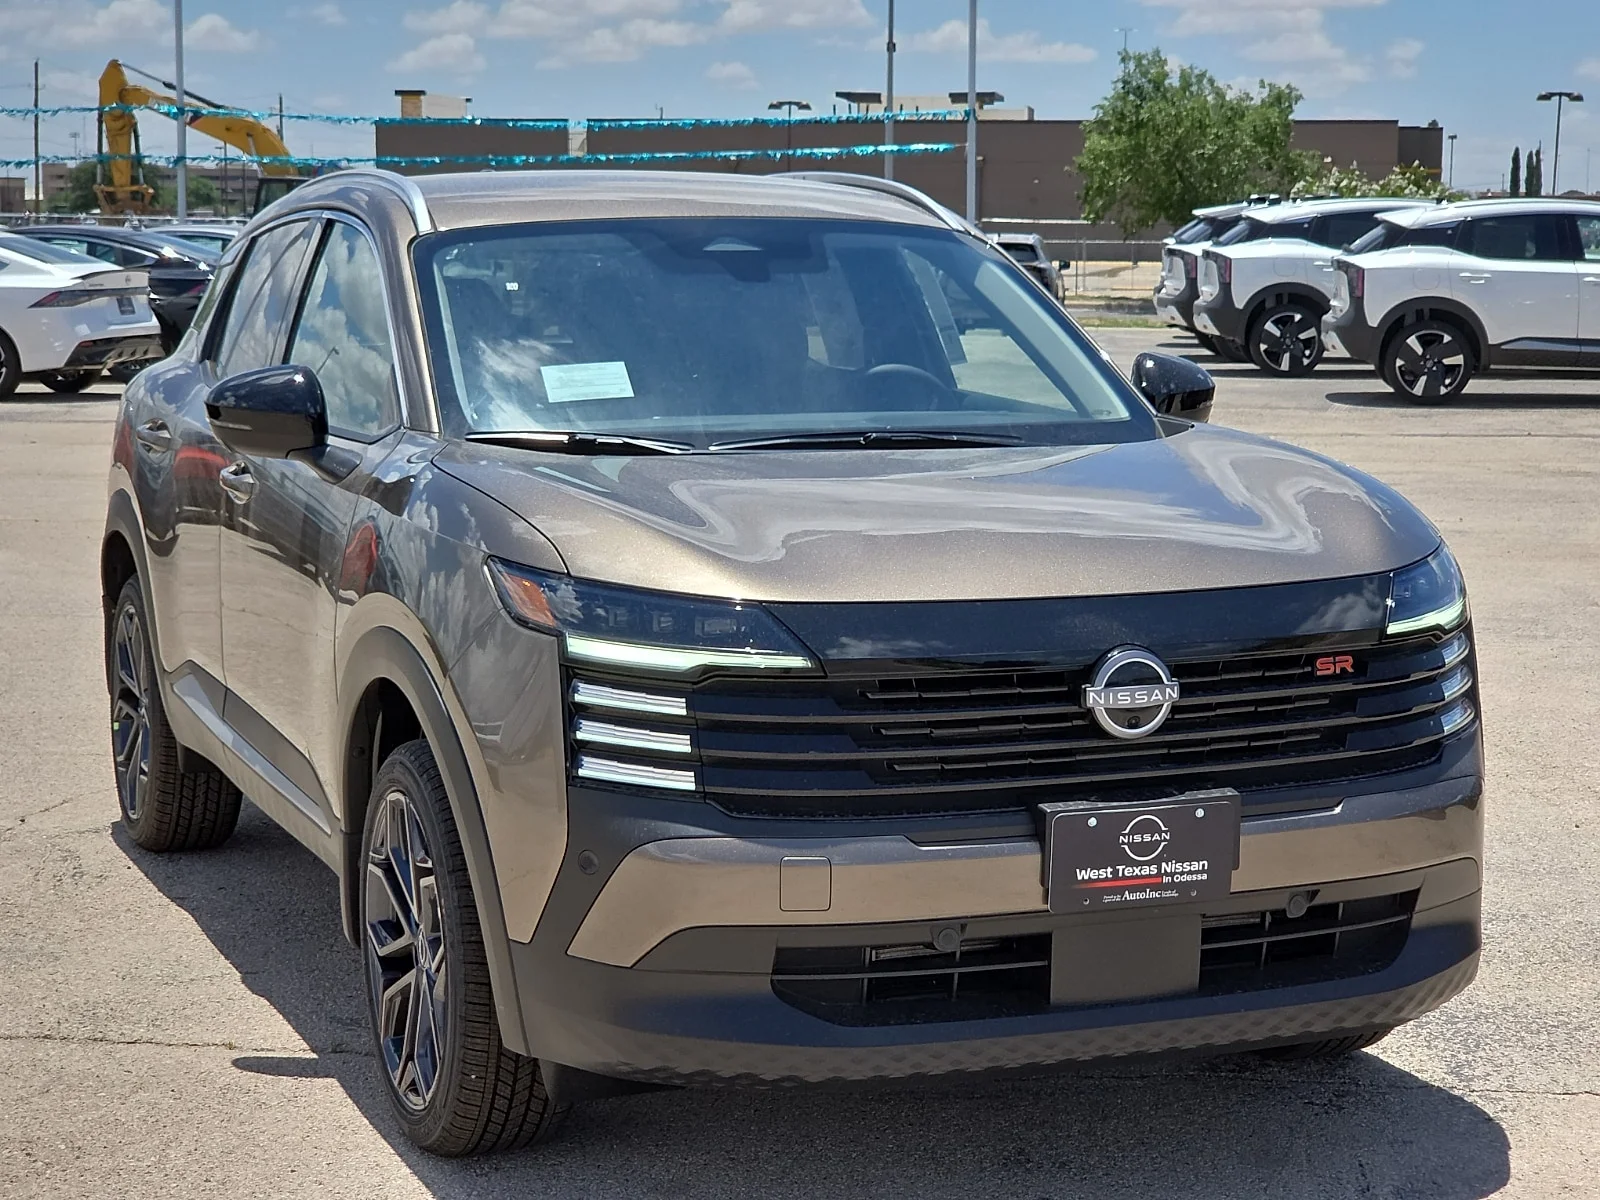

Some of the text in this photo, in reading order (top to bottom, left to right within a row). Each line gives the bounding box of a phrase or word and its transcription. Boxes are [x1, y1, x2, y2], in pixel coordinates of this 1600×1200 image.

[1315, 655, 1354, 676] SR
[1089, 686, 1178, 705] NISSAN
[1119, 832, 1170, 844] NISSAN
[1075, 860, 1208, 880] West Texas Nissan
[1173, 872, 1208, 883] Odessa
[1121, 888, 1161, 901] AutoInc
